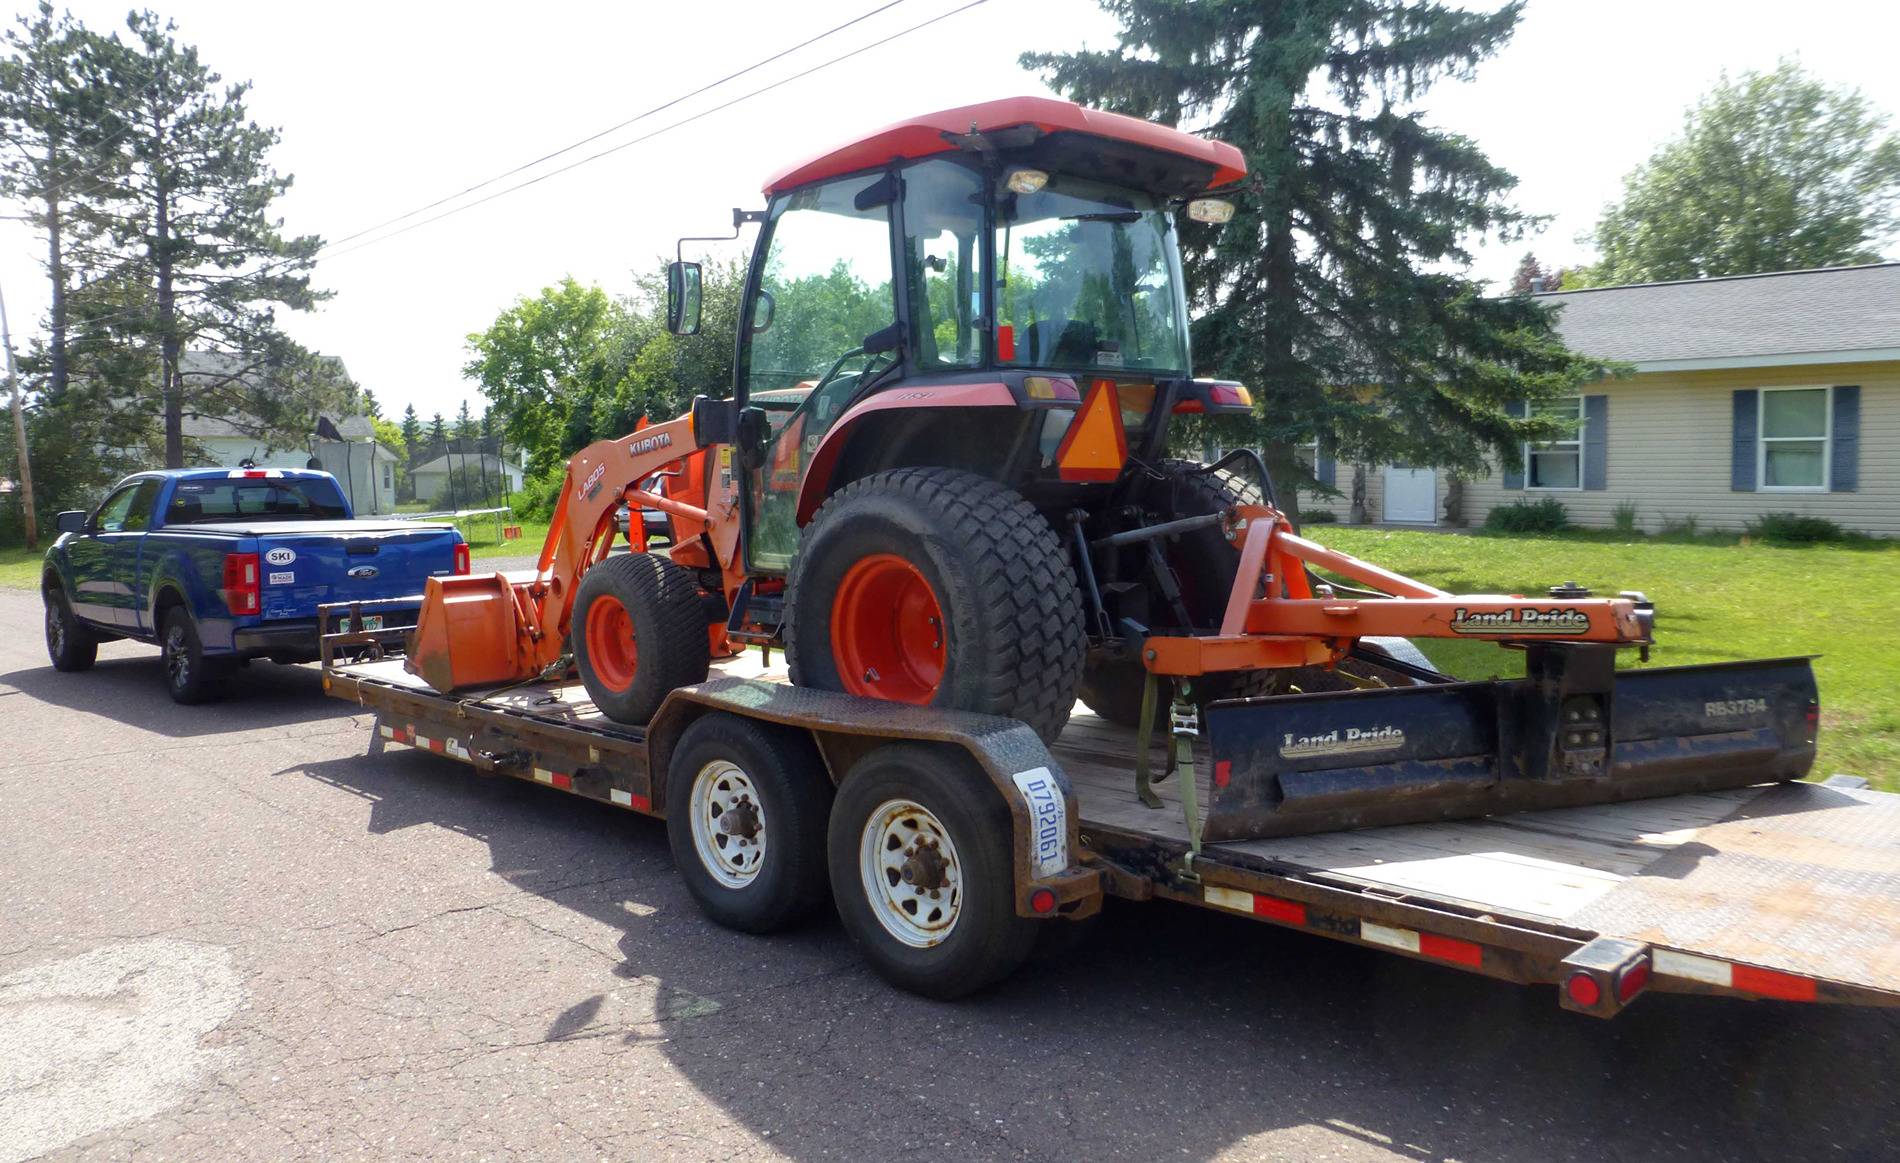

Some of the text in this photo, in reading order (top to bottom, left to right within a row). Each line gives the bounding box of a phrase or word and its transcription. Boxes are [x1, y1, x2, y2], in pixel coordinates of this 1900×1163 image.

[630, 432, 672, 457] KUBOTA
[271, 552, 291, 561] SKI
[1452, 607, 1588, 627] Land Pride
[1283, 726, 1402, 751] Land Pride
